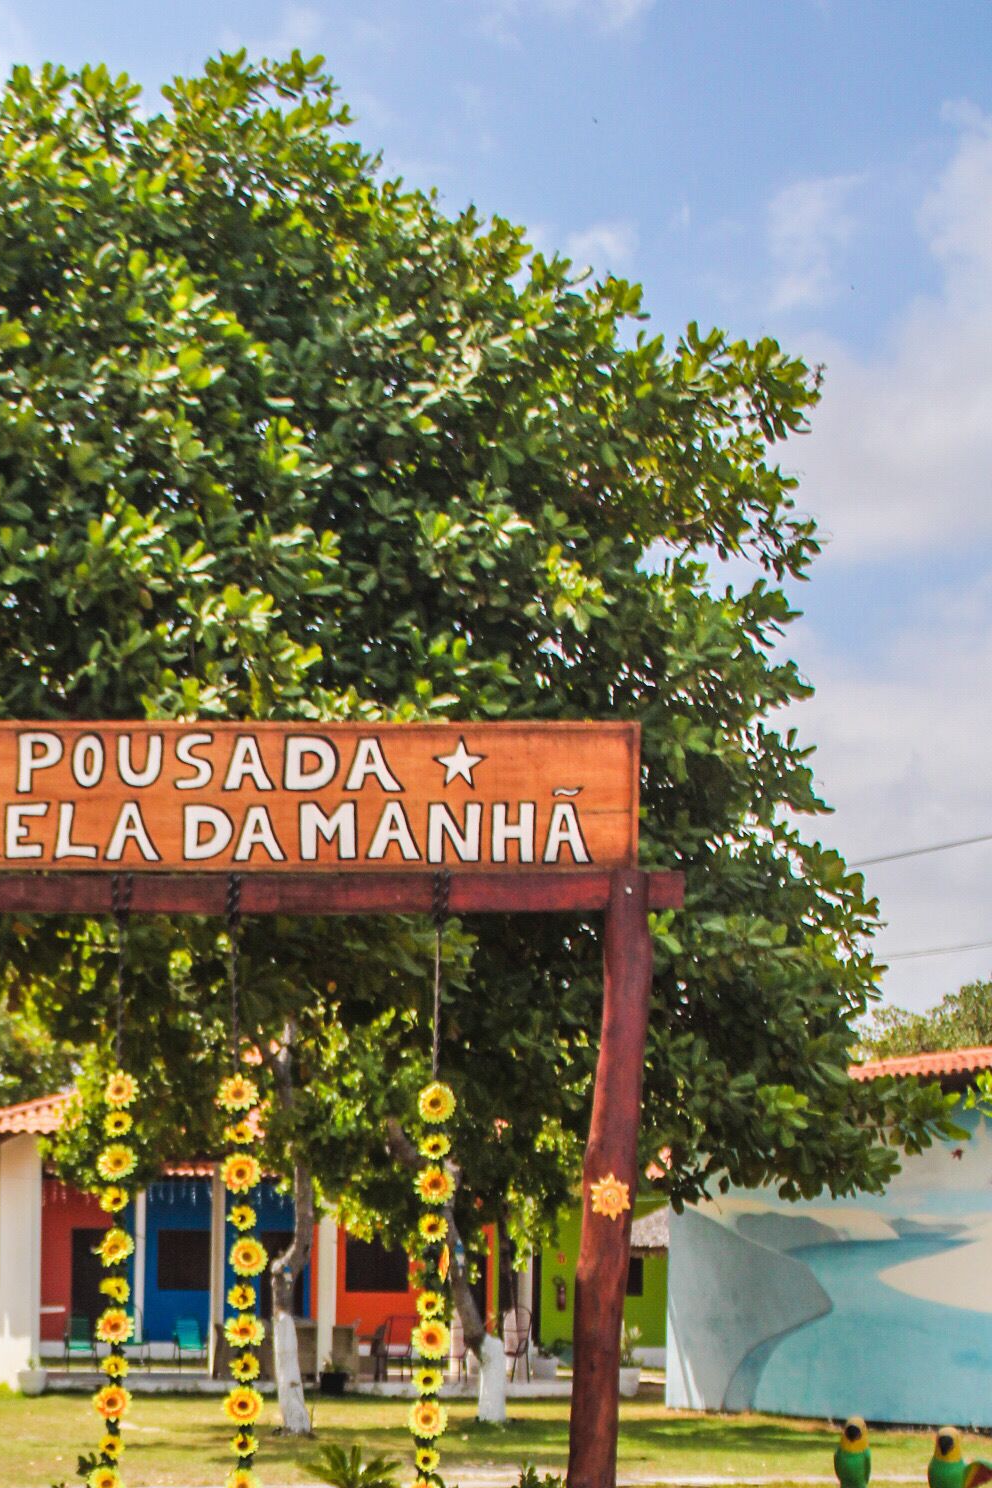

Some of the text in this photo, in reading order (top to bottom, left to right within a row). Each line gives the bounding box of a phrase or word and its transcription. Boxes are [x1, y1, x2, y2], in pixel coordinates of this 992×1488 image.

[16, 731, 405, 793] POUSADA
[183, 803, 287, 861] DA
[299, 786, 593, 864] MANHÃ
